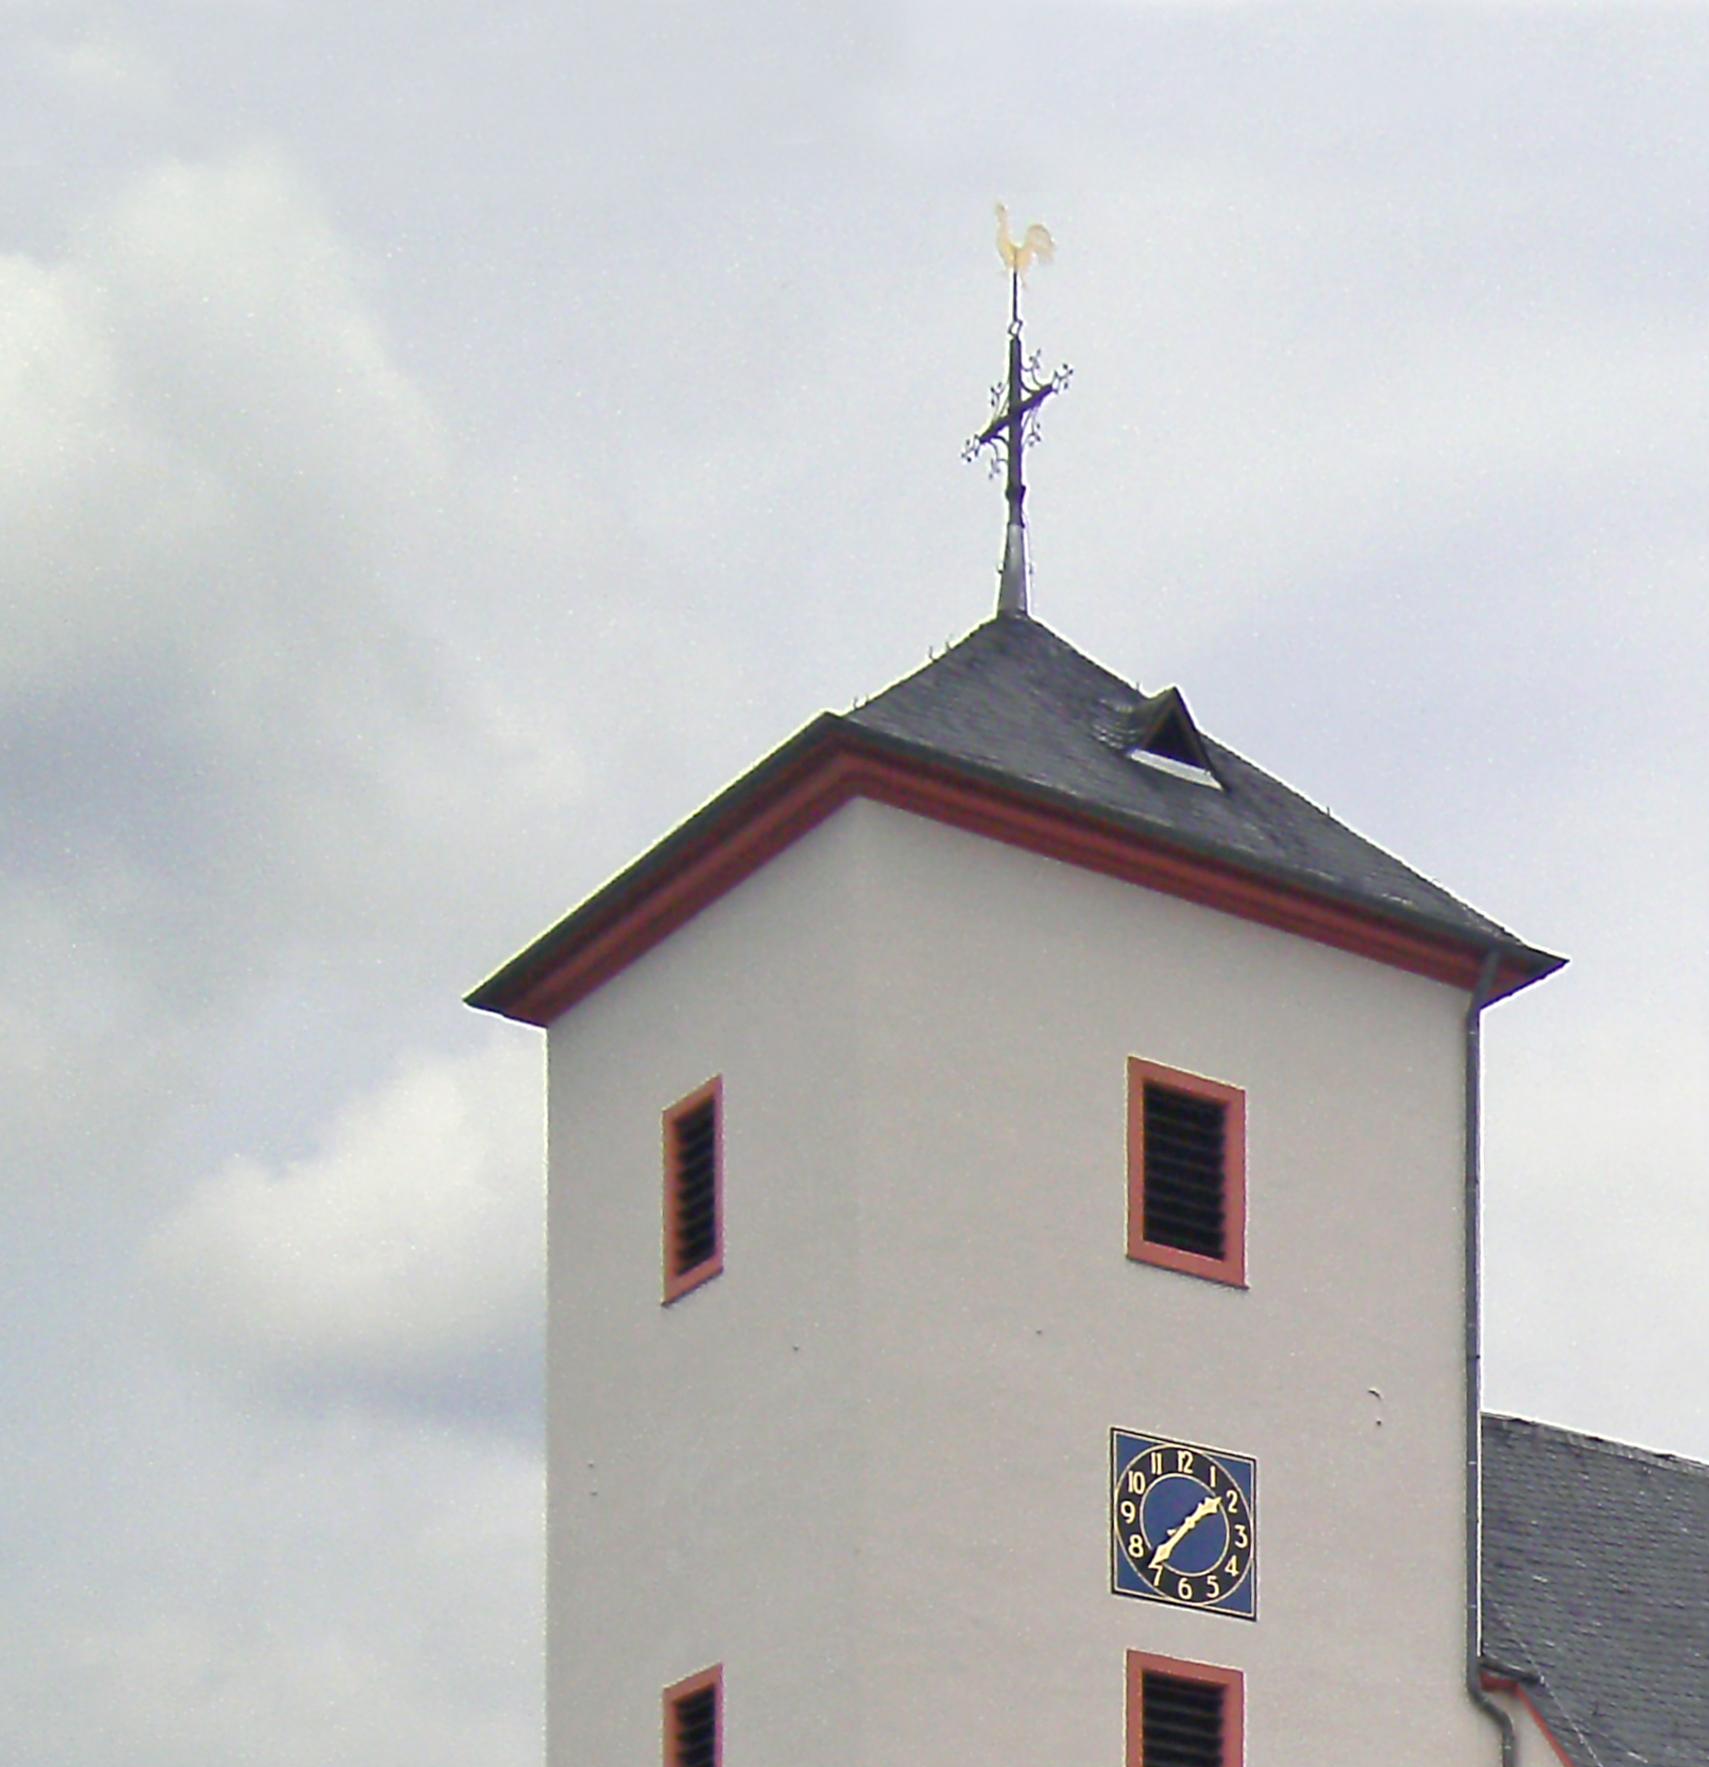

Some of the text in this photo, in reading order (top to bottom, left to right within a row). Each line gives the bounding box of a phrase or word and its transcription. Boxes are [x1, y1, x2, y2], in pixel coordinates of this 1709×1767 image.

[1151, 1452, 1163, 1475] 11
[1177, 1450, 1194, 1474] 12
[1128, 1470, 1145, 1495] 10
[1210, 1465, 1216, 1488] 1
[1120, 1501, 1136, 1524] 9
[1226, 1489, 1239, 1513] 2
[1128, 1534, 1144, 1558] 8
[1234, 1524, 1248, 1548] 3
[1152, 1563, 1163, 1586] 7
[1225, 1555, 1239, 1576] 4
[1178, 1578, 1192, 1600] 6
[1206, 1575, 1220, 1598] 5
